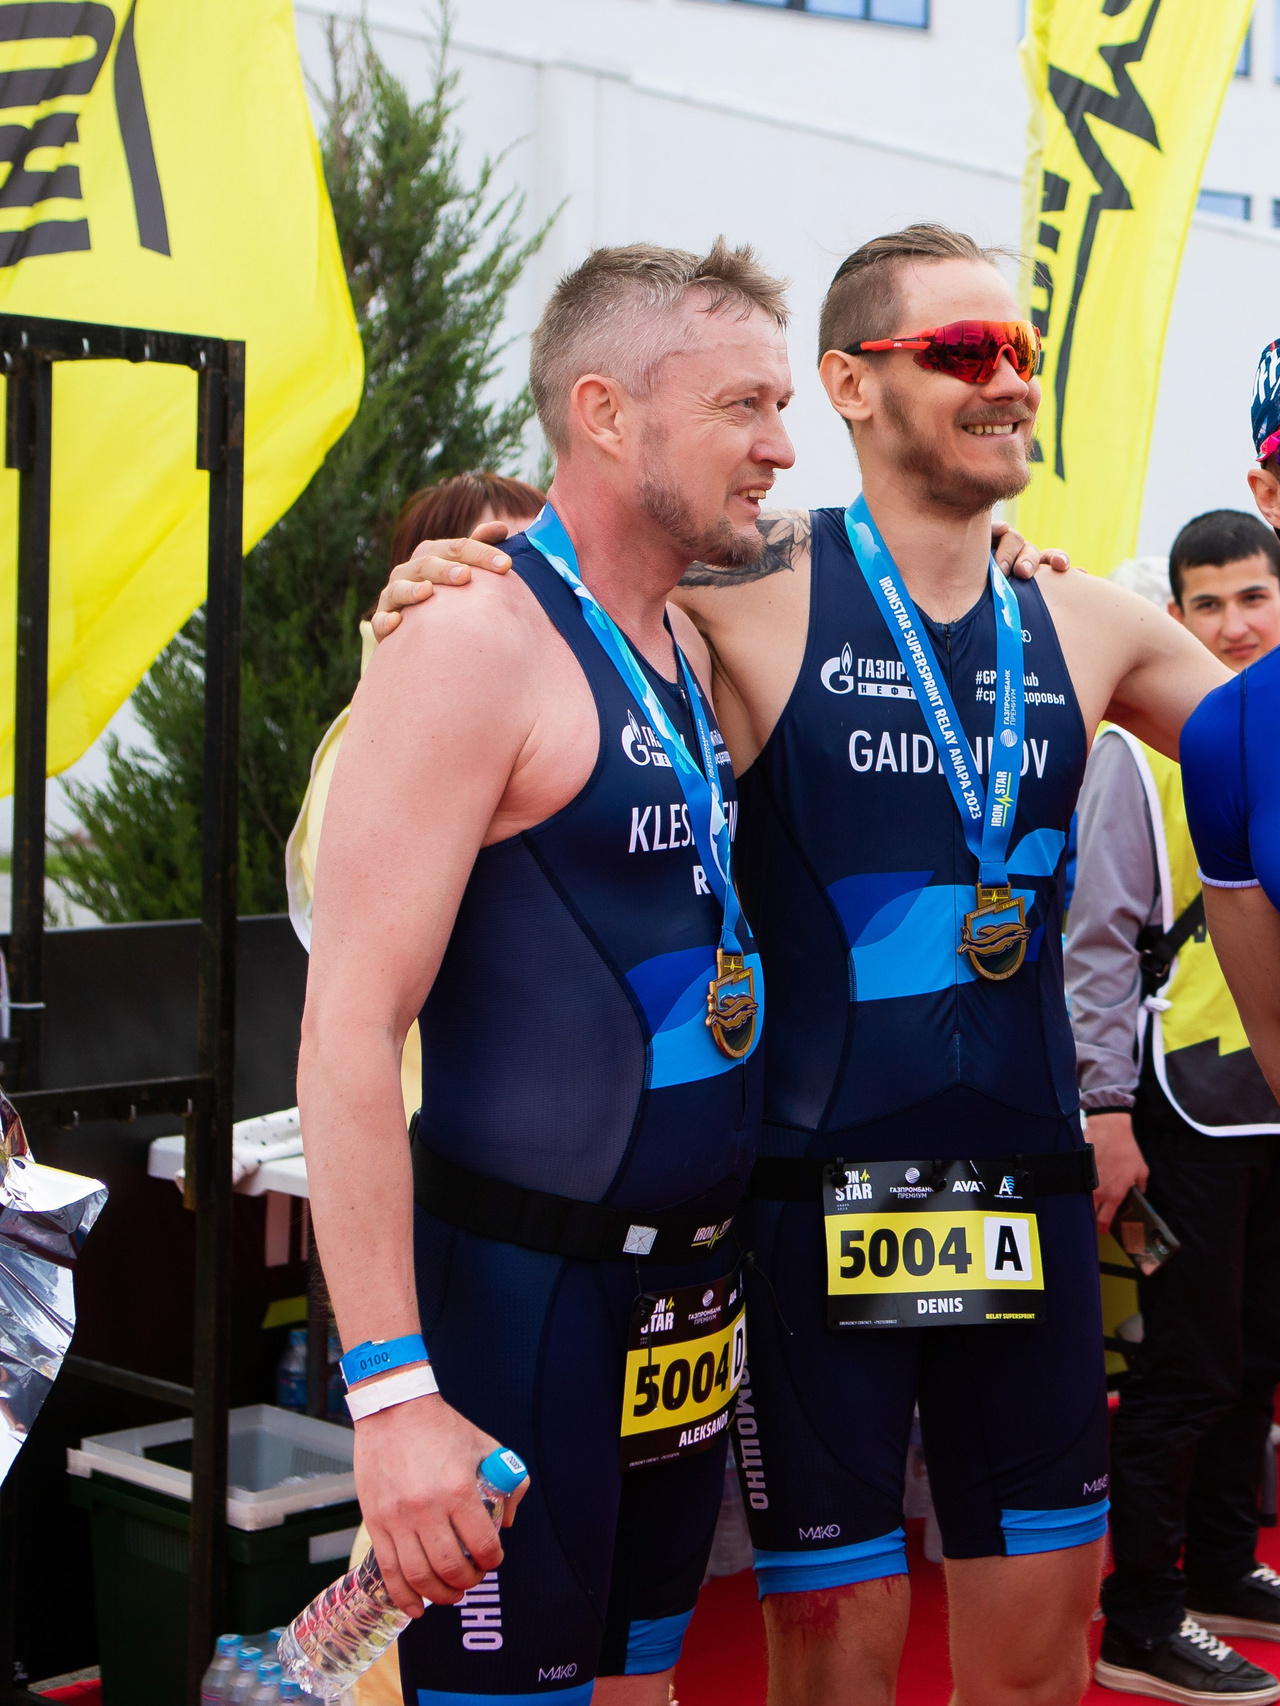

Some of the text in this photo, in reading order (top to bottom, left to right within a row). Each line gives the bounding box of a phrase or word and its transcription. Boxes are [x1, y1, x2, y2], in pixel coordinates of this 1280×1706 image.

[858, 658, 912, 681] ГАЗПР
[861, 684, 914, 697] НЕФТ
[879, 575, 982, 819] IRONSTAR SUPERSPRINT RELAY ANAPA 2023
[991, 771, 1008, 827] IRON STAR
[835, 1183, 873, 1201] STAR
[952, 1181, 980, 1193] AVA
[693, 1225, 717, 1242] IRON
[840, 1225, 1023, 1279] 5004 A
[917, 1298, 964, 1315] DENIS
[641, 1312, 674, 1334] STAR
[360, 1352, 389, 1371] 0100
[633, 1341, 730, 1418] 5004
[679, 1410, 729, 1448] ALEKSANDR
[799, 1524, 841, 1541] MAKO
[538, 1662, 577, 1682] MAKO
